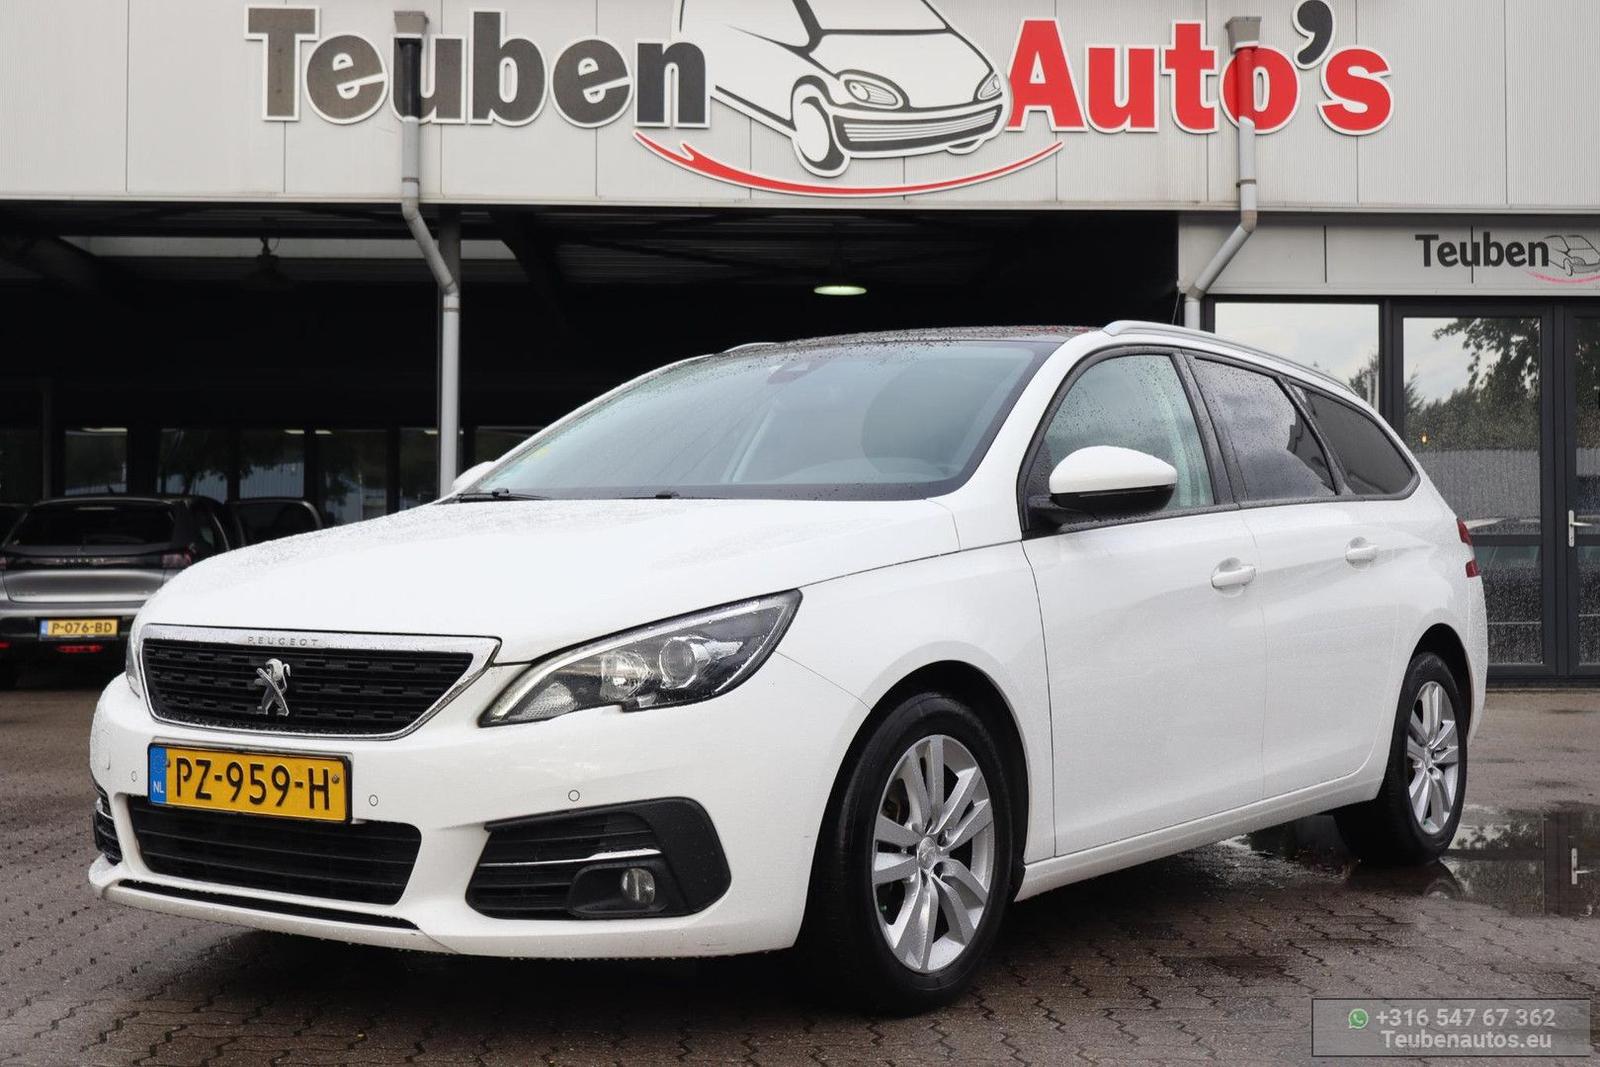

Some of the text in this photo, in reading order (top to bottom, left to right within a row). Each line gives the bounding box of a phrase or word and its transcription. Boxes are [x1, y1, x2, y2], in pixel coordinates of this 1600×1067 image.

[246, 0, 1393, 134] Teuben Auto's
[1415, 231, 1549, 268] Teuben
[51, 622, 113, 633] P-076-BD
[247, 636, 319, 647] PEUGEOT
[152, 782, 164, 793] NL
[176, 757, 330, 810] PZ-959-H
